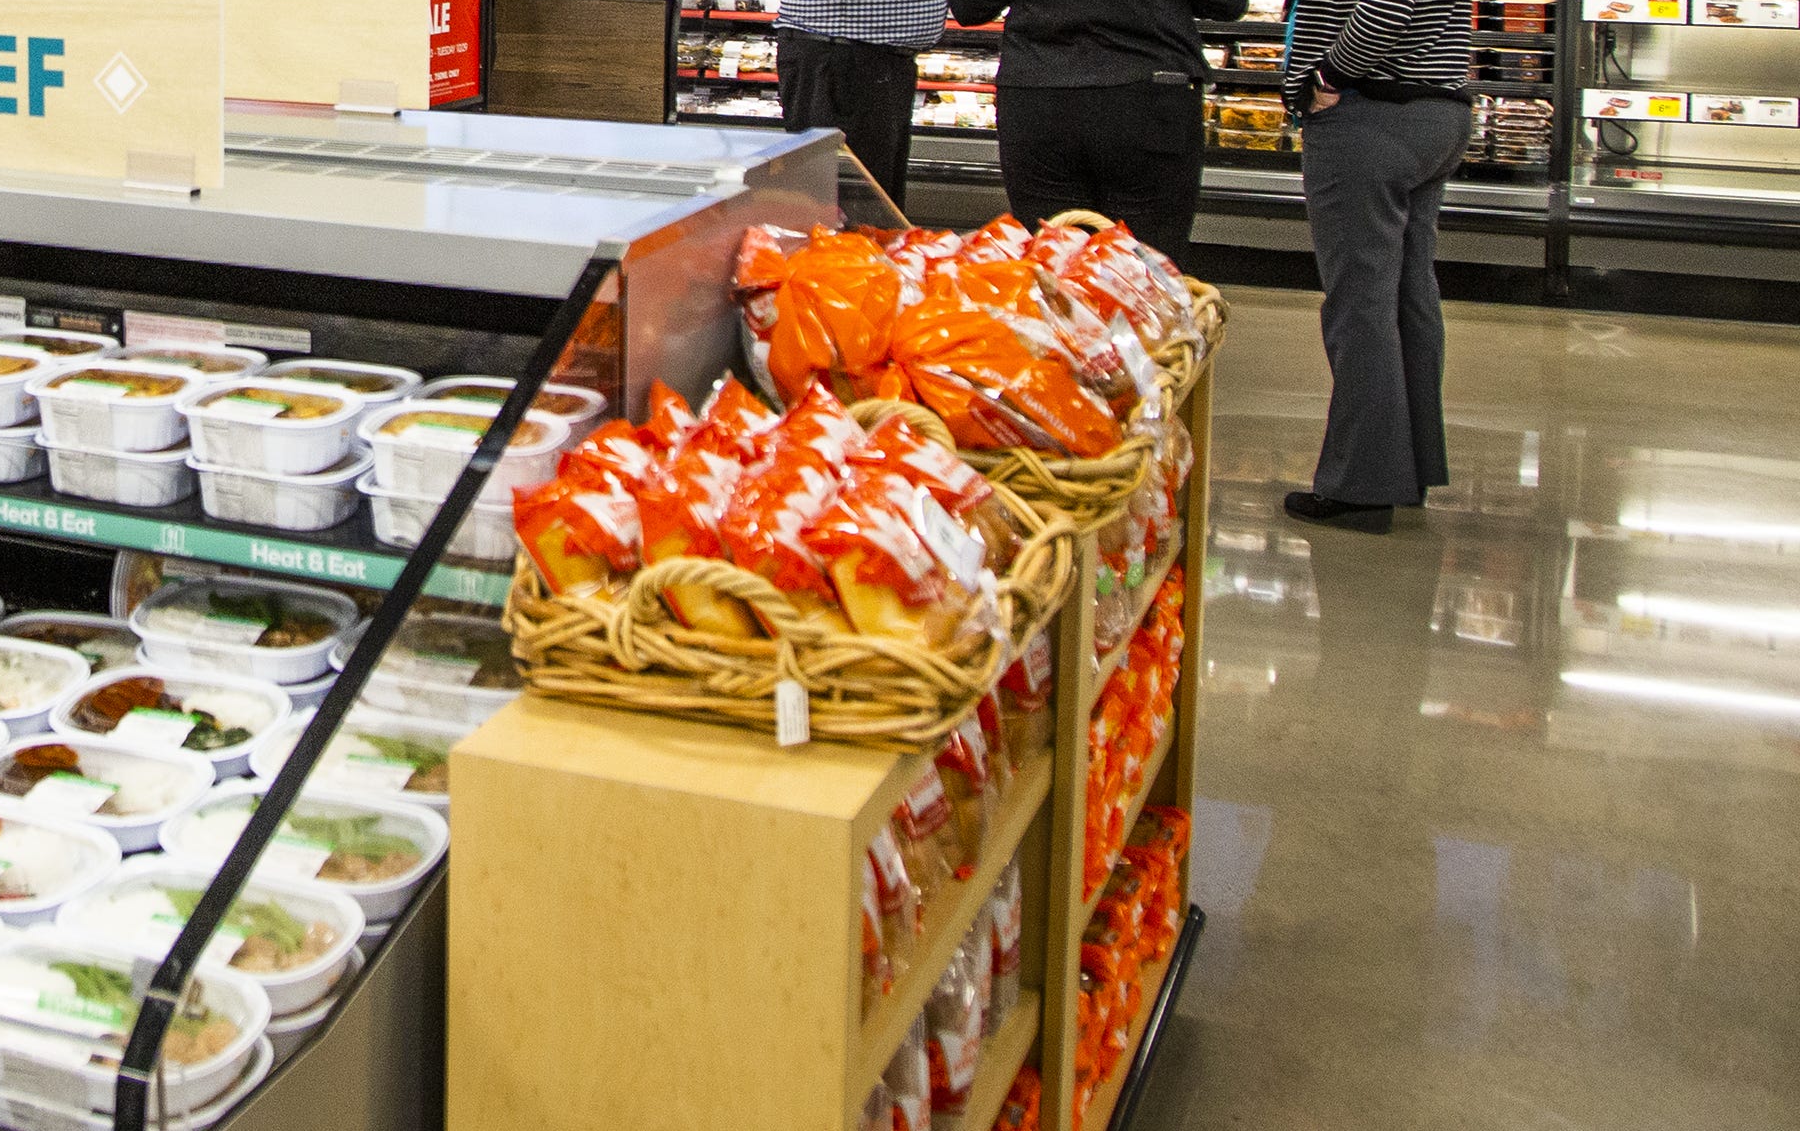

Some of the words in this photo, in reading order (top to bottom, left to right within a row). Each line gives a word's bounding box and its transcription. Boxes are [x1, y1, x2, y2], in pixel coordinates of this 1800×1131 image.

[43, 509, 58, 529] &
[61, 511, 96, 536] Eat
[250, 542, 305, 570] Heat
[308, 550, 325, 573] &
[327, 552, 366, 580] Eat
